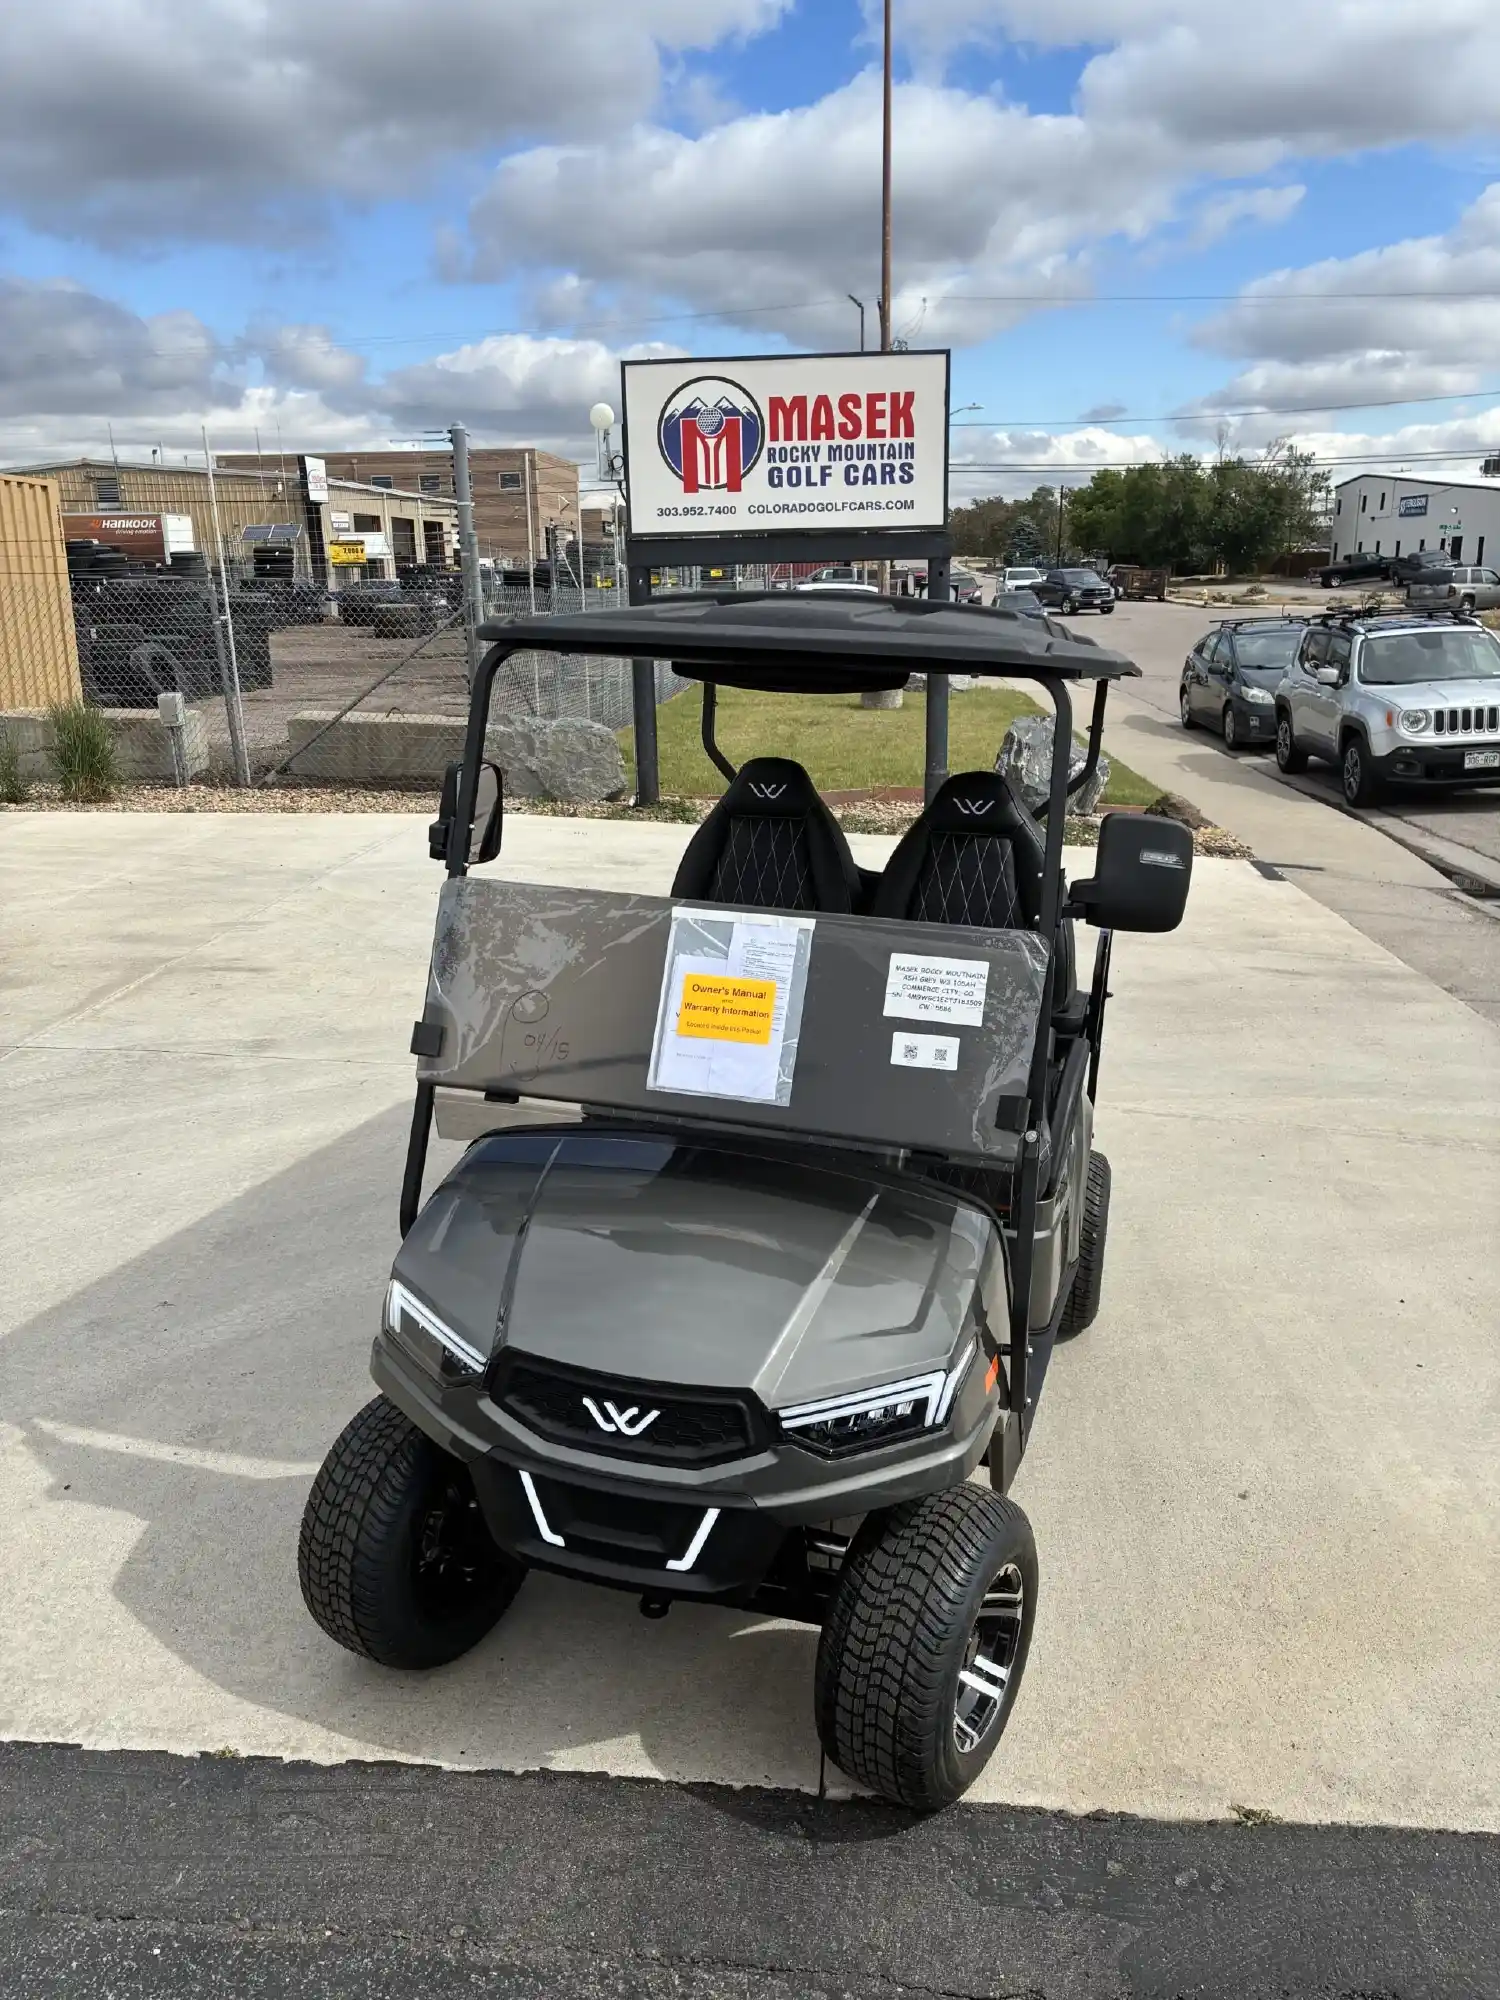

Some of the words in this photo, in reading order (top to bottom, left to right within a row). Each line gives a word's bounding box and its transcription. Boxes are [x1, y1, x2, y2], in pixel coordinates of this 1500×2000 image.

[768, 391, 915, 442] MASEK
[767, 445, 821, 463] ROCKY
[828, 442, 915, 462] MOUNTAIN
[768, 465, 832, 488] GOLF
[844, 462, 915, 486] CARS
[657, 505, 737, 517] 303.952.7400
[747, 500, 915, 515] COLORADOGOLFCARS.COM
[895, 965, 918, 973] MASEK
[946, 970, 986, 980] MOUTNAIN
[692, 983, 730, 996] Owner's
[732, 988, 767, 1000] Manual
[902, 984, 940, 994] COMMERCE
[684, 1002, 720, 1015] Warranty
[722, 1006, 770, 1019] Information
